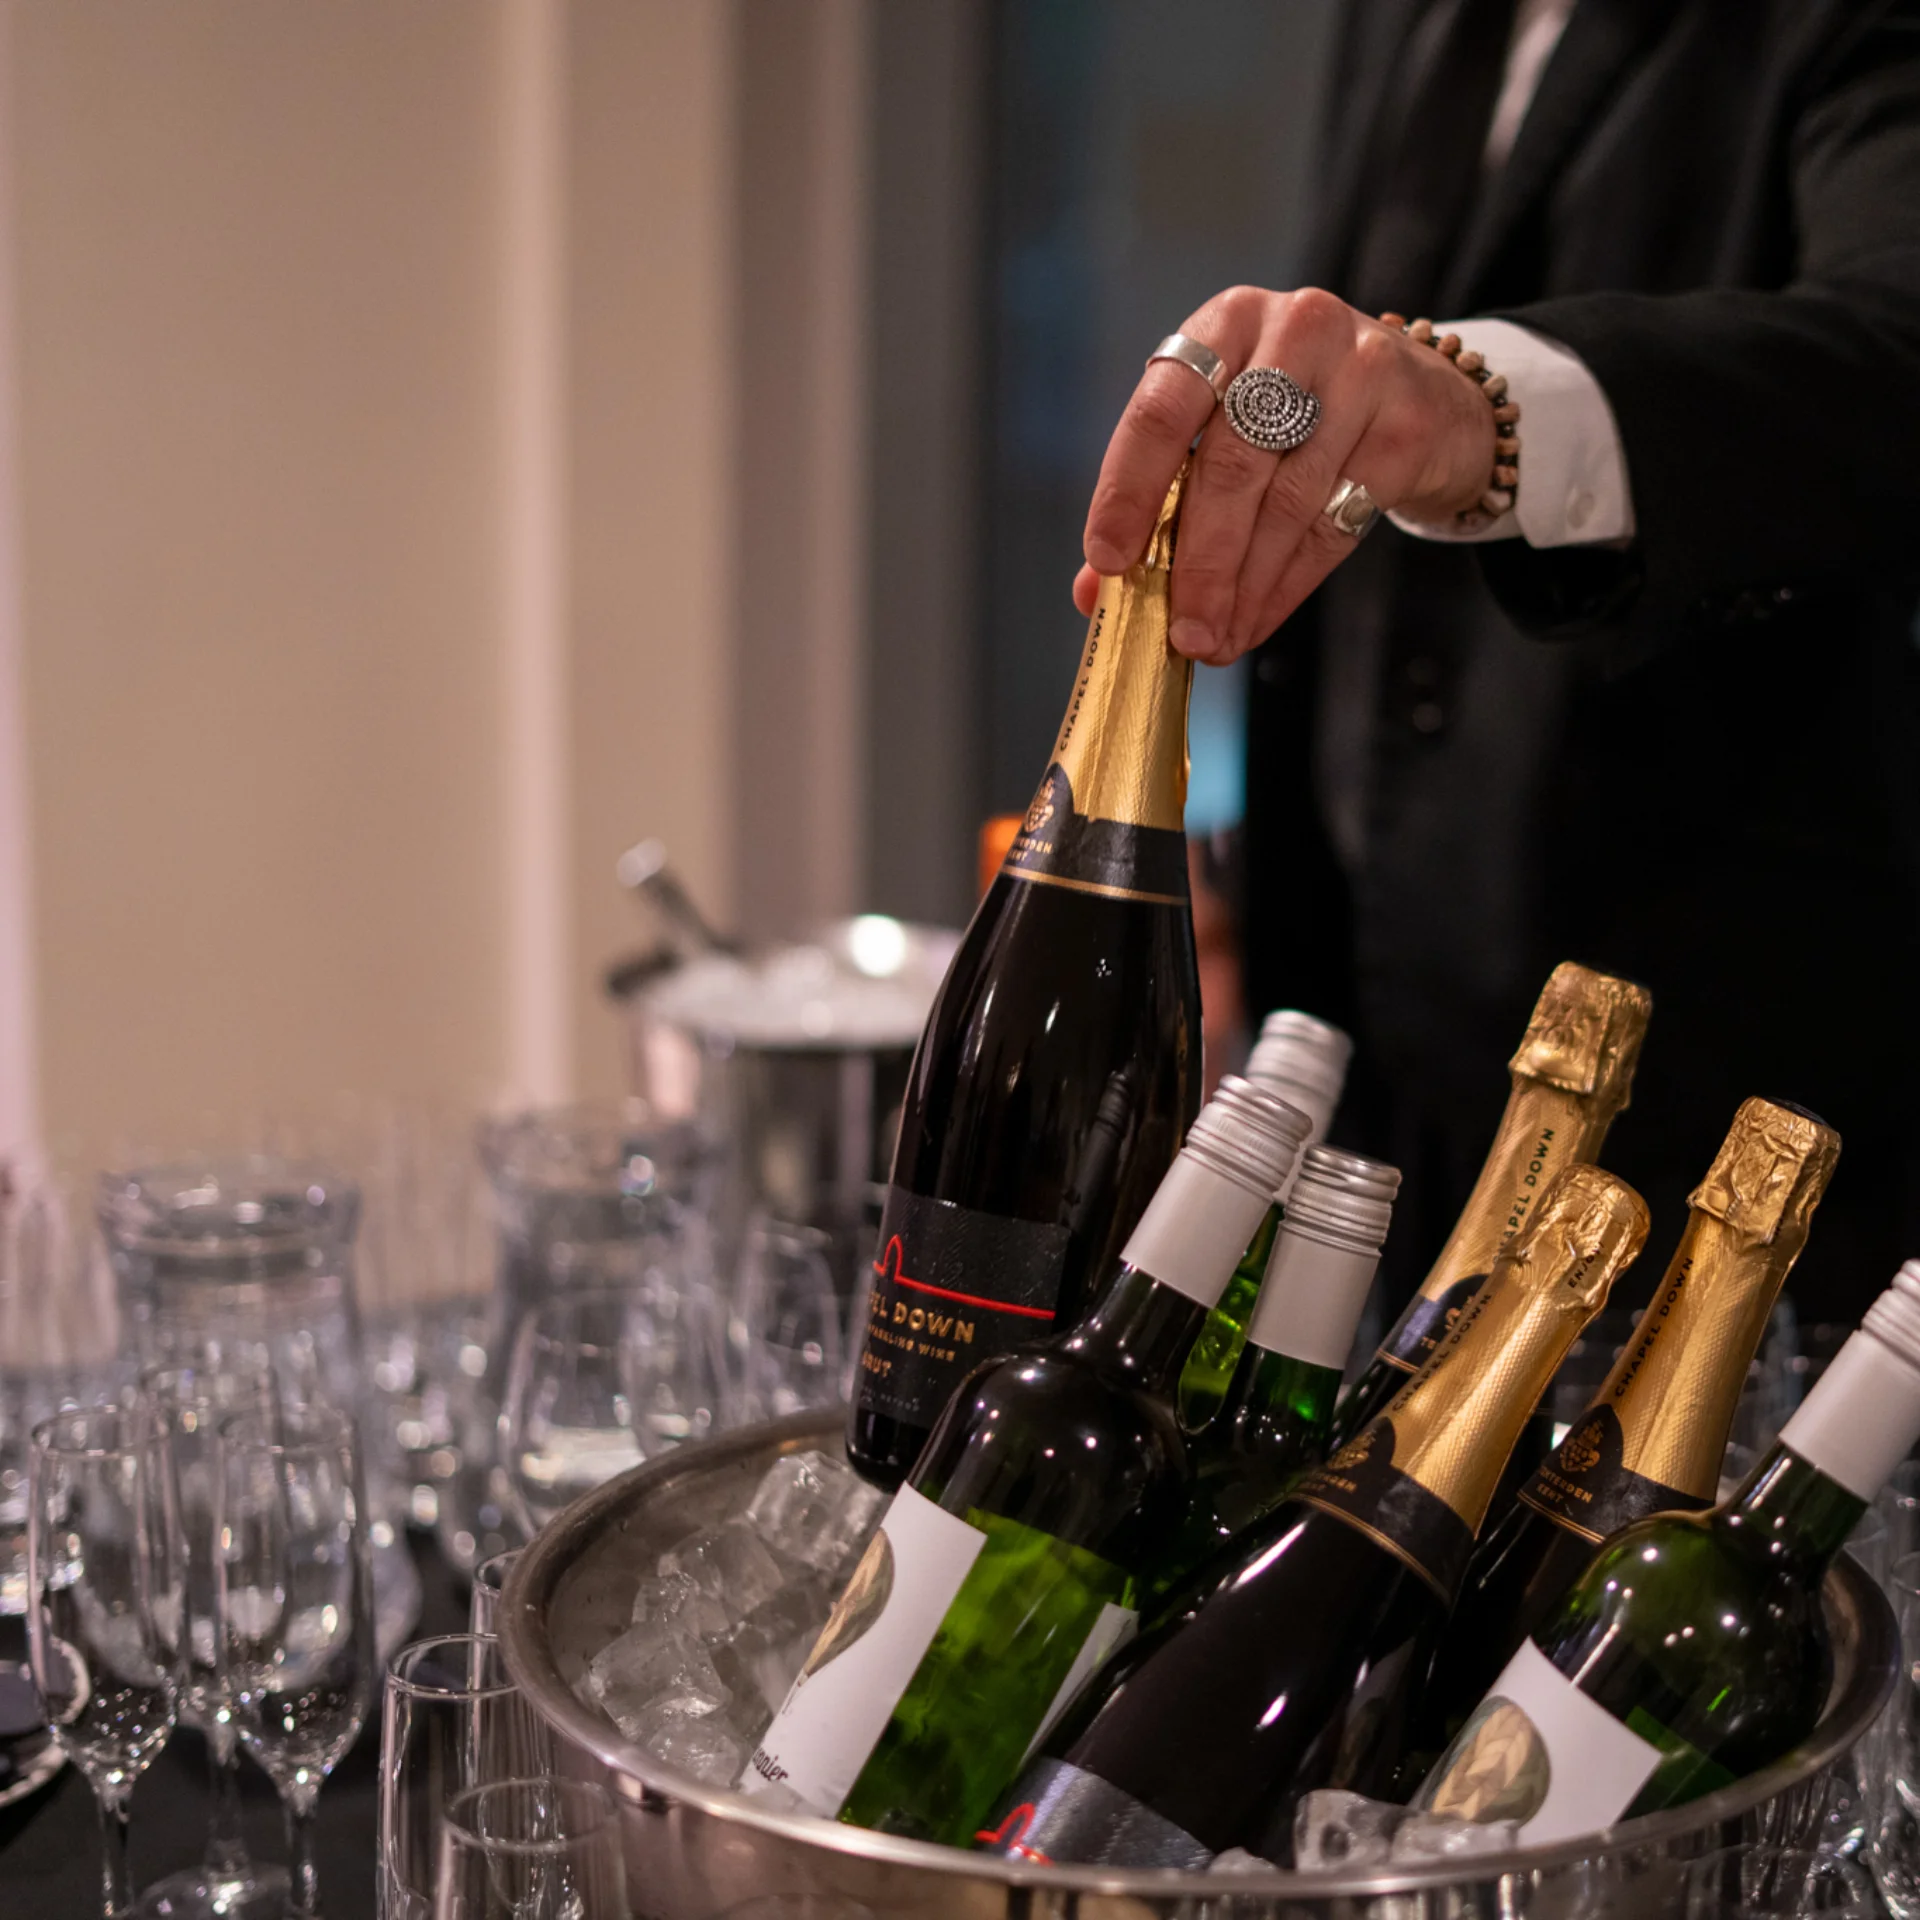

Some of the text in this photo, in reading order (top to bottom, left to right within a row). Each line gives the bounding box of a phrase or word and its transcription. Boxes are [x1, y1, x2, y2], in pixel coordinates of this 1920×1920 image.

[1060, 608, 1105, 751] CHAPEL DOWN
[1525, 1128, 1555, 1187] DOWN
[893, 1301, 975, 1344] DOWN
[1614, 1258, 1693, 1398] CHAPEL DOWN
